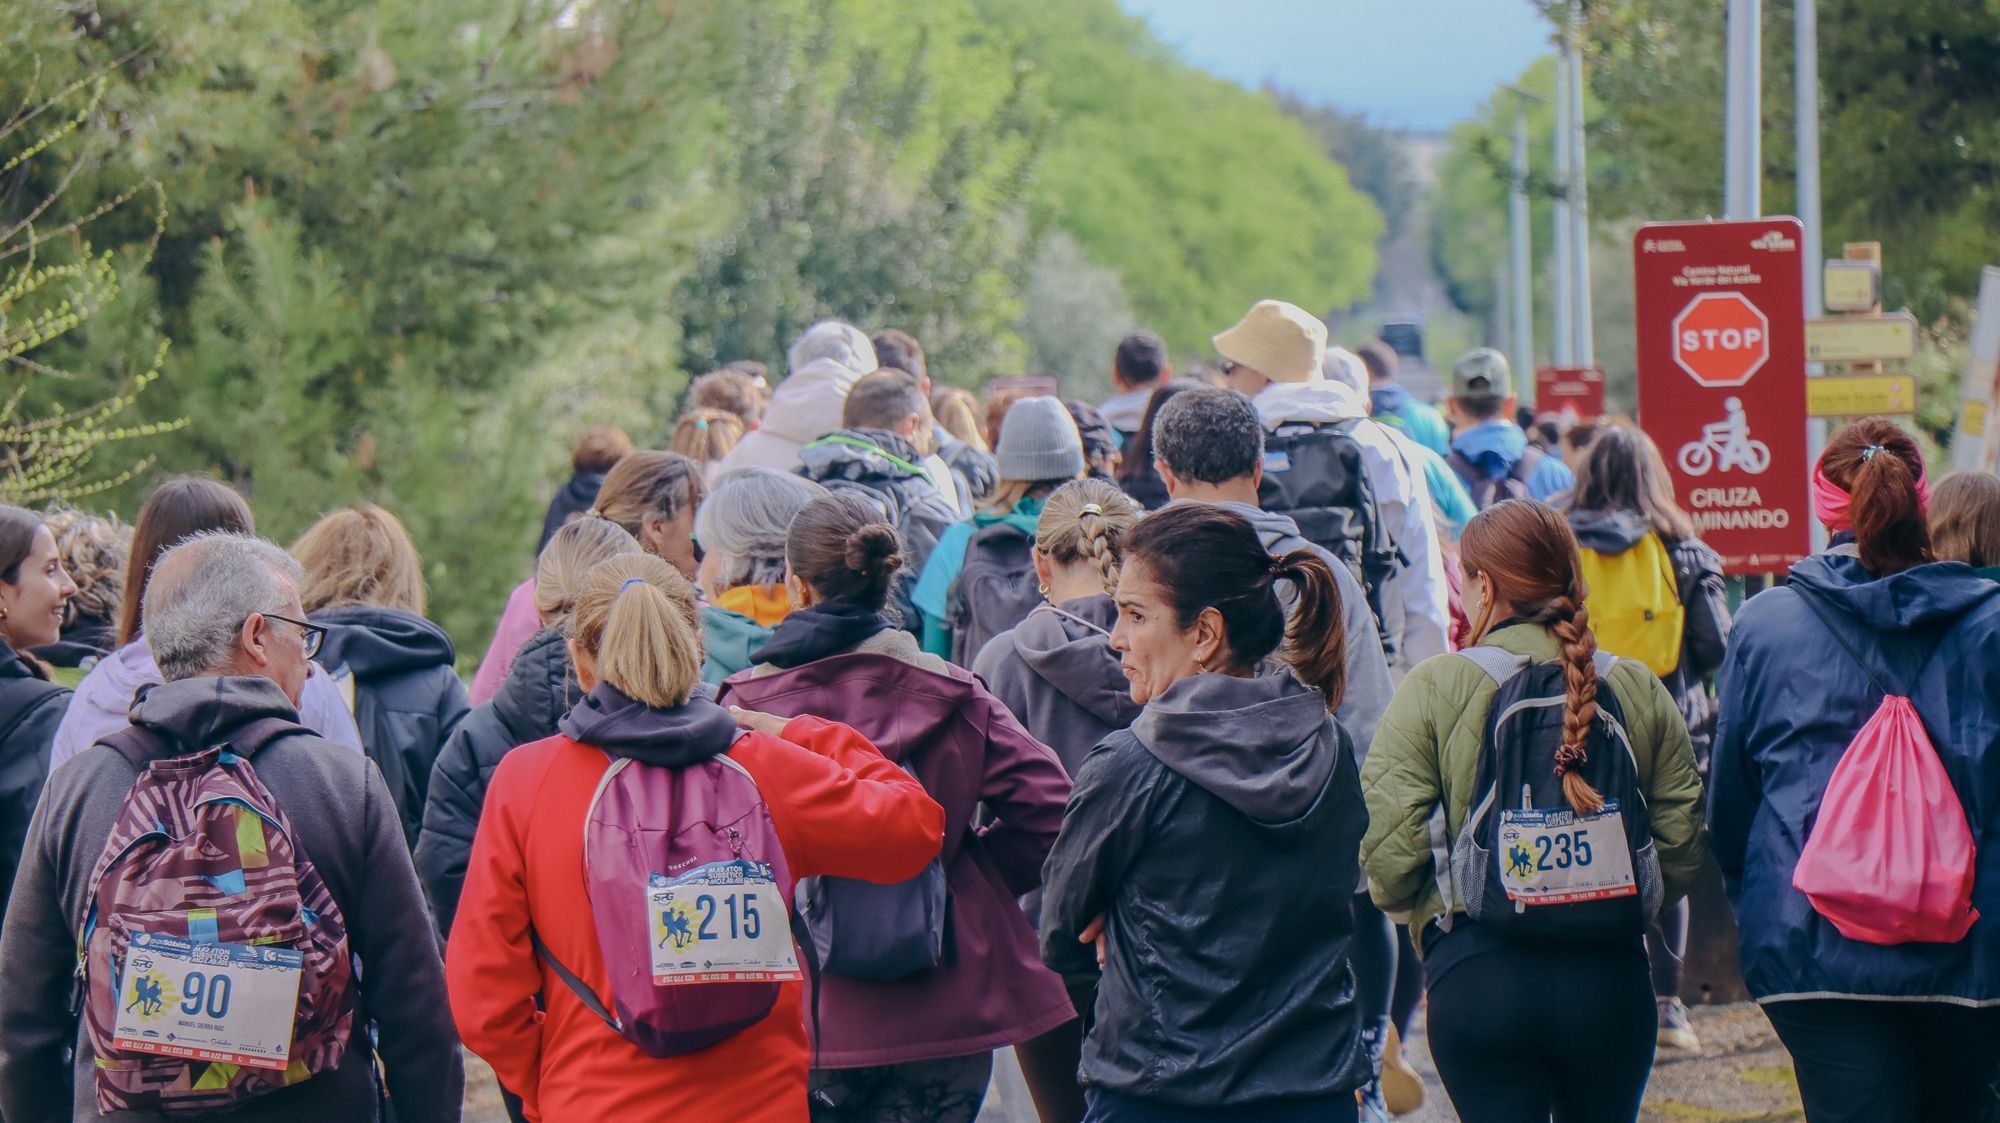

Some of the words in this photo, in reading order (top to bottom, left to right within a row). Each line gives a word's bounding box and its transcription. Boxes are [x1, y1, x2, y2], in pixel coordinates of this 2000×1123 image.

[1682, 266, 1717, 276] Camino
[1717, 264, 1751, 275] Natural
[1682, 327, 1762, 352] STOP
[1690, 487, 1762, 508] CRUZA
[1690, 508, 1790, 530] MINANDO
[1535, 829, 1592, 872] 235
[668, 855, 698, 871] QUECHUA
[696, 893, 761, 940] 215
[132, 959, 154, 969] SPG
[181, 971, 232, 1019] 90
